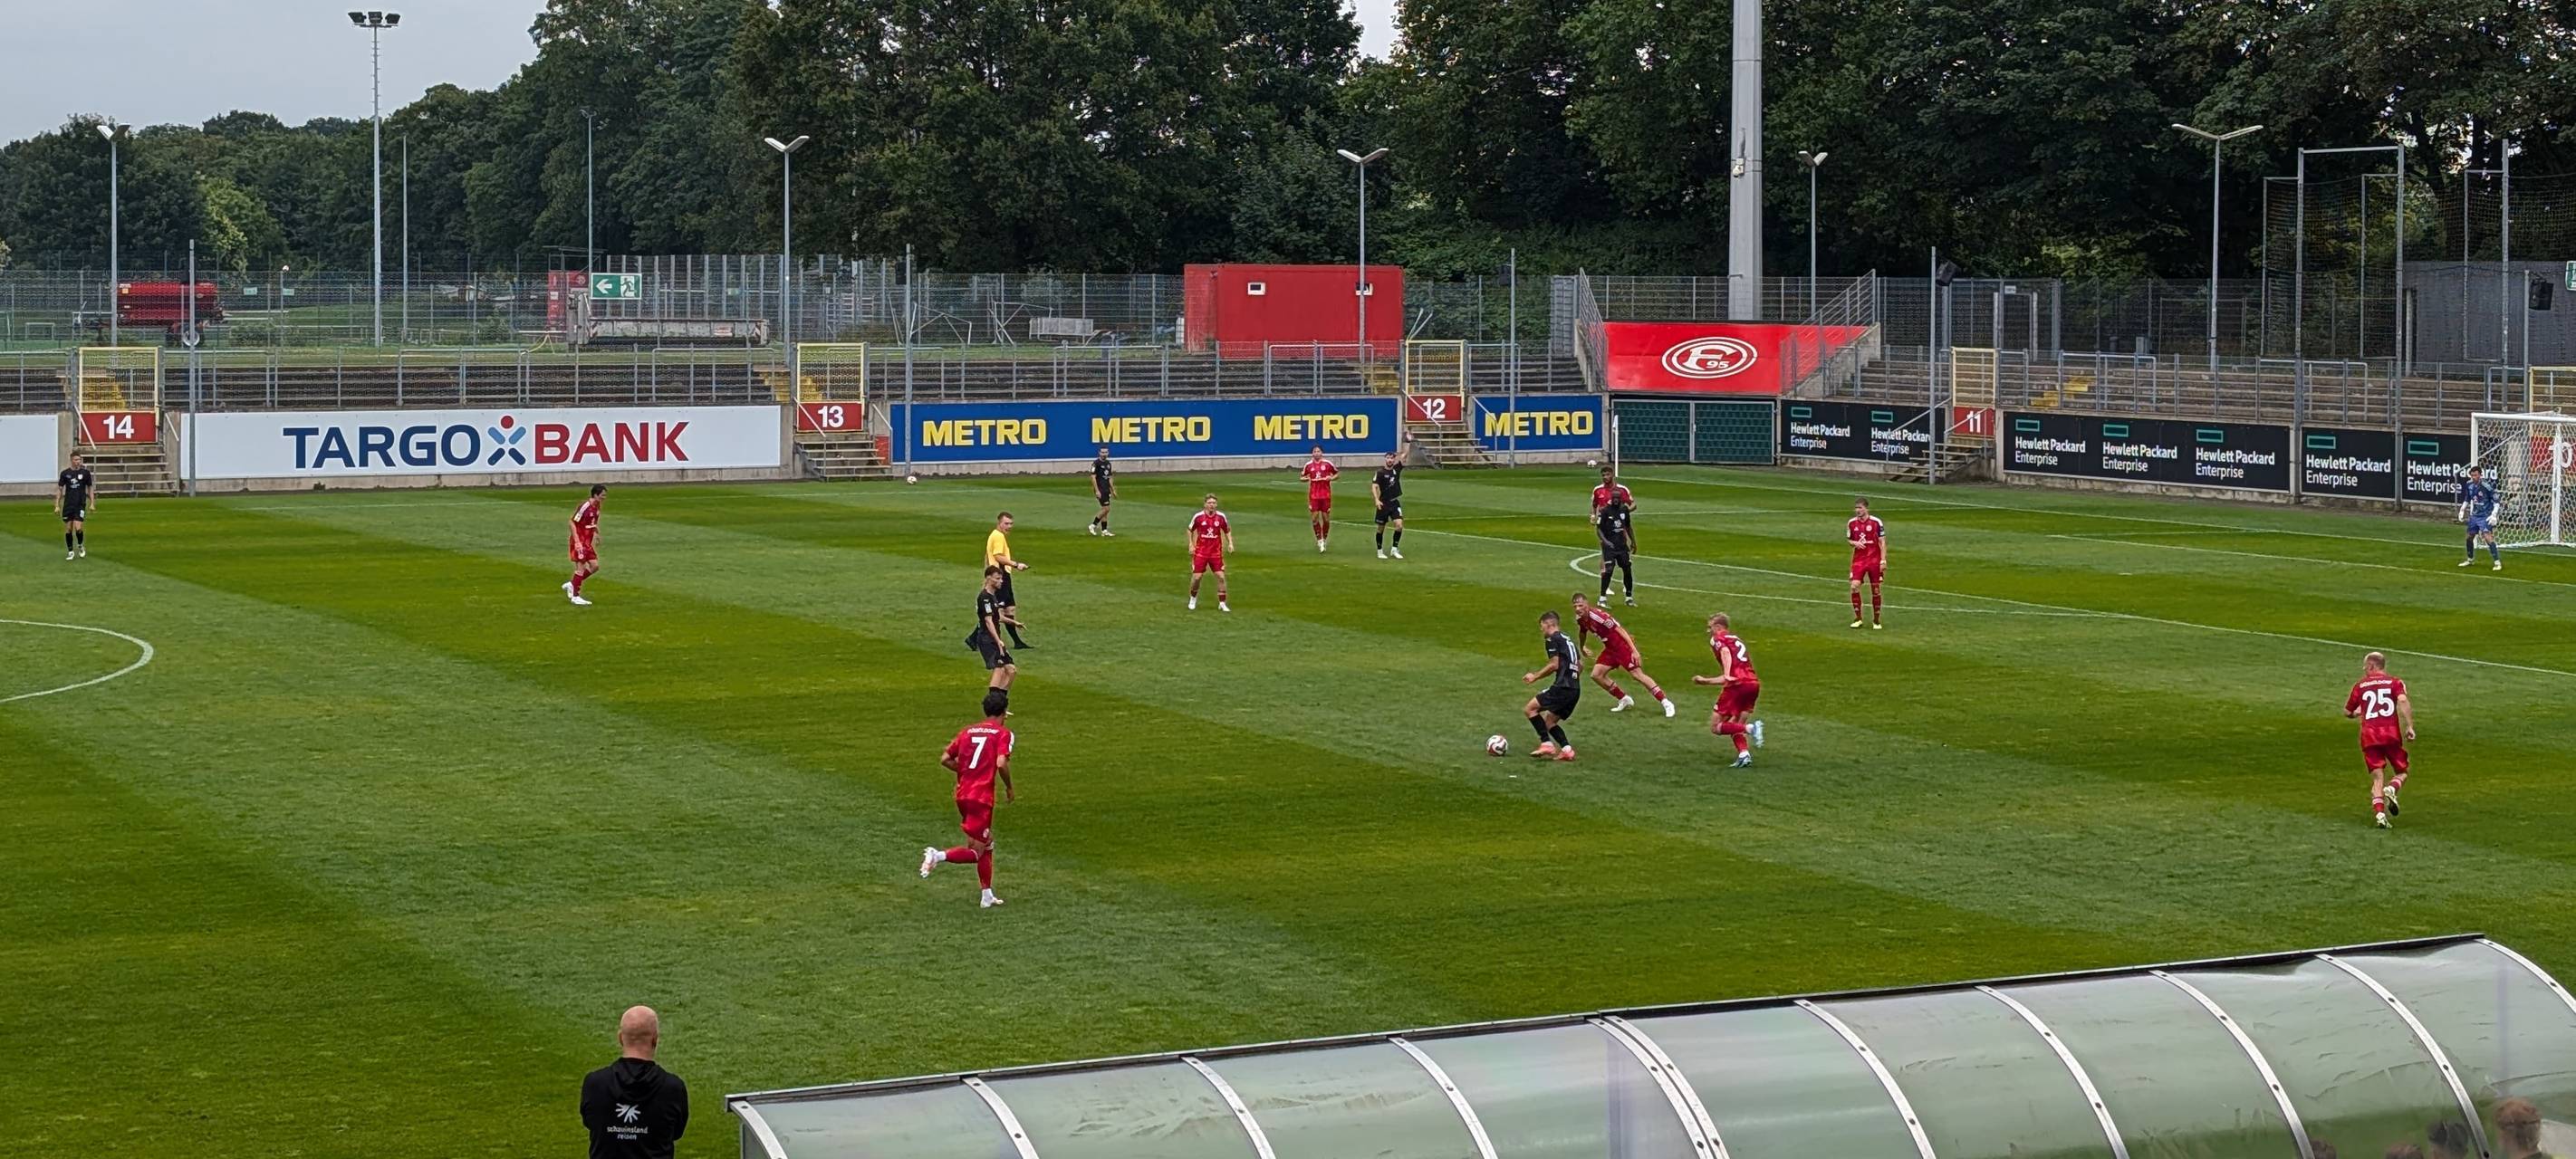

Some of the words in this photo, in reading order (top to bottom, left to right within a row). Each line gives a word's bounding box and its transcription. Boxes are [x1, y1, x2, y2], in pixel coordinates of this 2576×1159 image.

[818, 406, 844, 428] 13
[1423, 398, 1446, 419] 12
[103, 415, 134, 439] 14
[923, 419, 1047, 446] METRO
[1091, 416, 1211, 444] METRO
[1254, 415, 1369, 441] METRO
[1485, 410, 1593, 436] METRO
[1790, 422, 1820, 436] Hewlett
[1820, 425, 1850, 437] Packard
[1790, 436, 1827, 451] Enterprise
[1870, 426, 1901, 441] Hewlett
[1902, 429, 1931, 443] Packar
[1871, 441, 1909, 456] Enterprise
[2015, 436, 2049, 451] Hewlett
[2050, 440, 2086, 454] Packard
[2102, 442, 2139, 457] Hewlett
[2139, 445, 2178, 459] Packard
[2015, 451, 2058, 467] Enterprise
[2196, 447, 2235, 463] Hewlett
[2235, 450, 2275, 465] Packard
[2306, 455, 2348, 470] Hewlett
[2349, 457, 2391, 473] Packard
[2102, 457, 2148, 474] Enterprise
[2196, 463, 2244, 480] Enterprise
[2407, 460, 2451, 476] Hewlett
[2453, 463, 2498, 480] Pacard
[2306, 470, 2359, 488] Enterprise
[2407, 477, 2463, 495] Enterprise
[1735, 640, 1747, 662] 2
[2362, 688, 2395, 720] 25
[968, 736, 987, 769] 7
